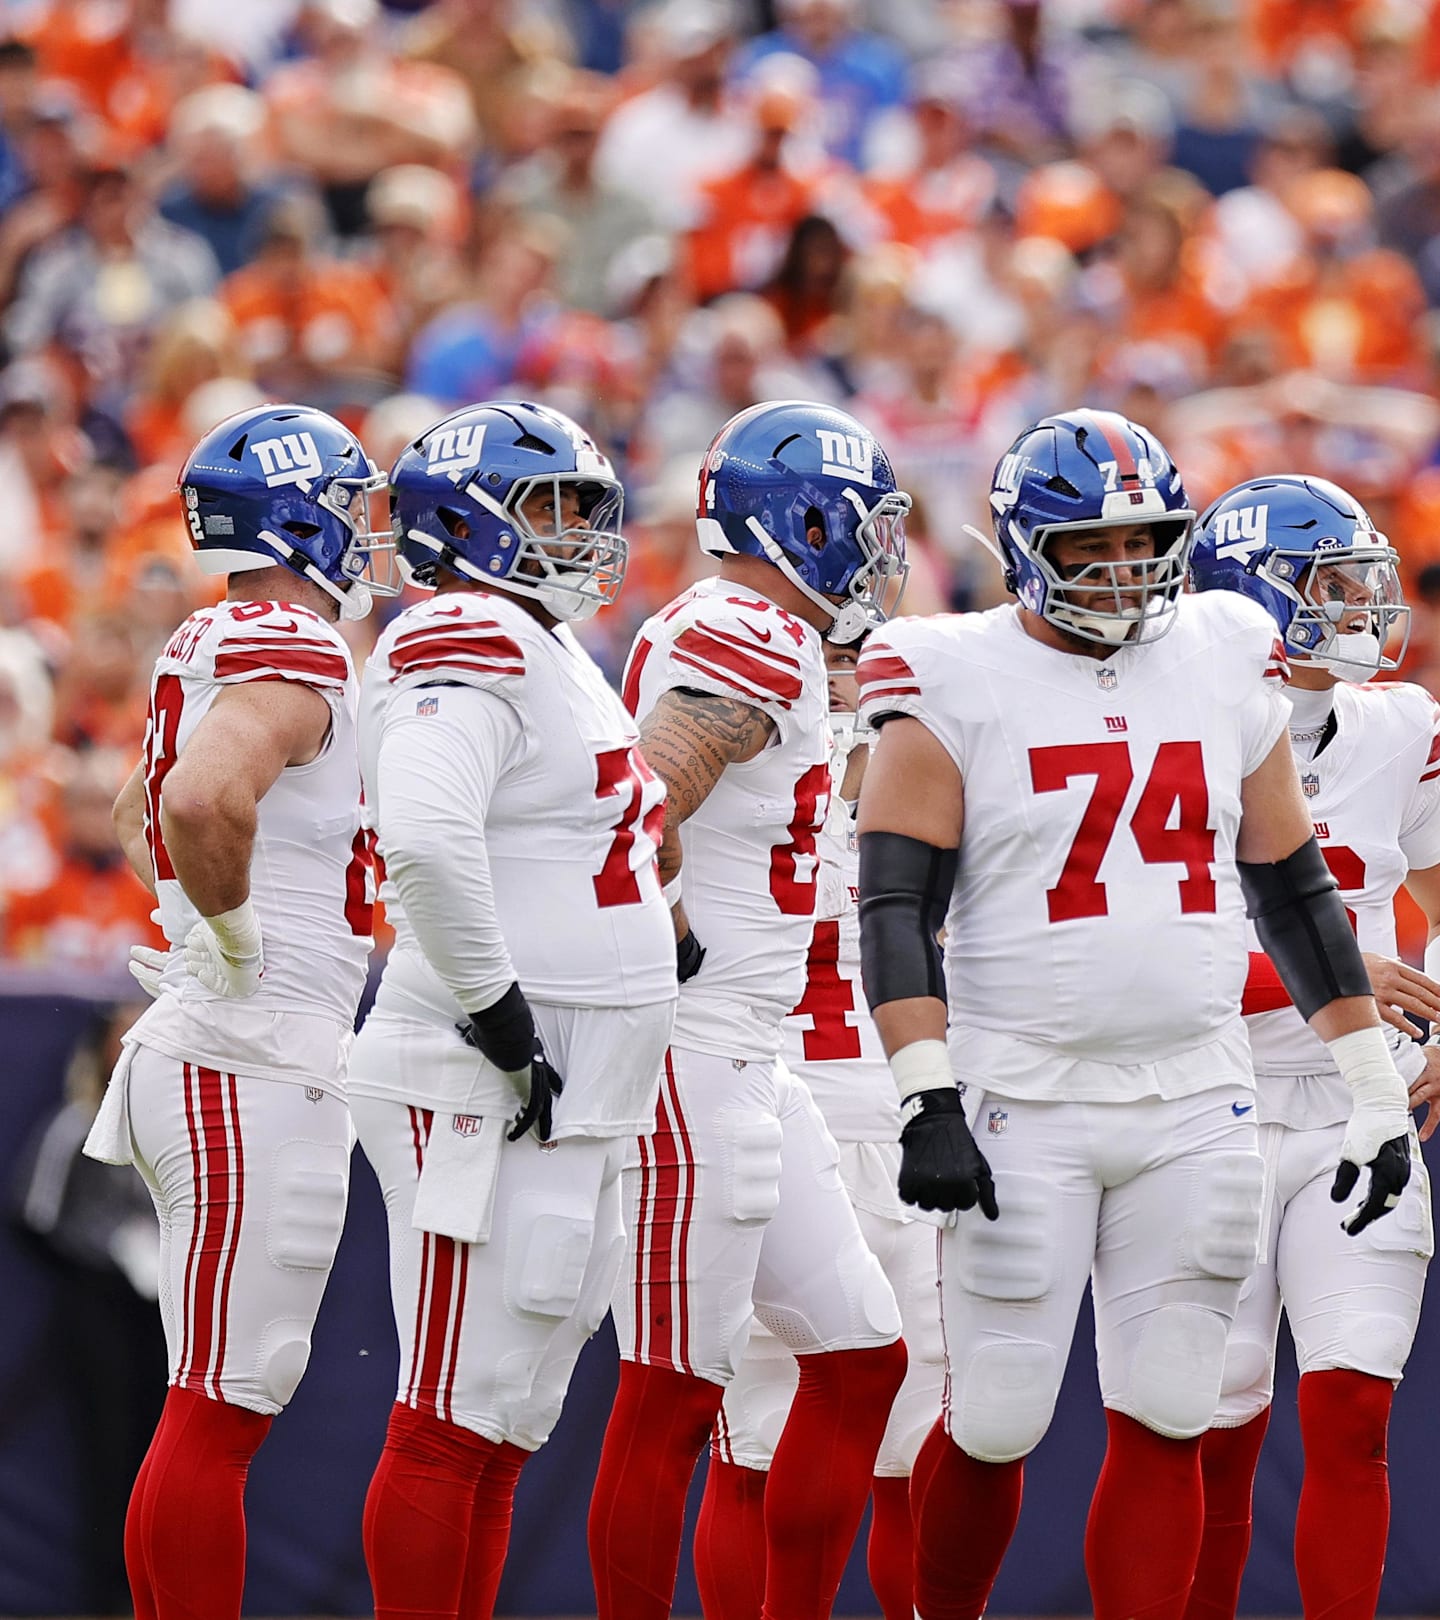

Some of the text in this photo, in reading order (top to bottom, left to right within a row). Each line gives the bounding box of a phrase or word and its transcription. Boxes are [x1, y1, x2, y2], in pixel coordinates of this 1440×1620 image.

[250, 432, 323, 489] ny
[426, 424, 488, 476] ny
[816, 429, 873, 488] ny
[1099, 458, 1156, 492] 74
[1215, 505, 1269, 561] ny
[1103, 715, 1128, 733] ny
[1028, 740, 1217, 923] 74
[455, 1115, 479, 1135] NFL
